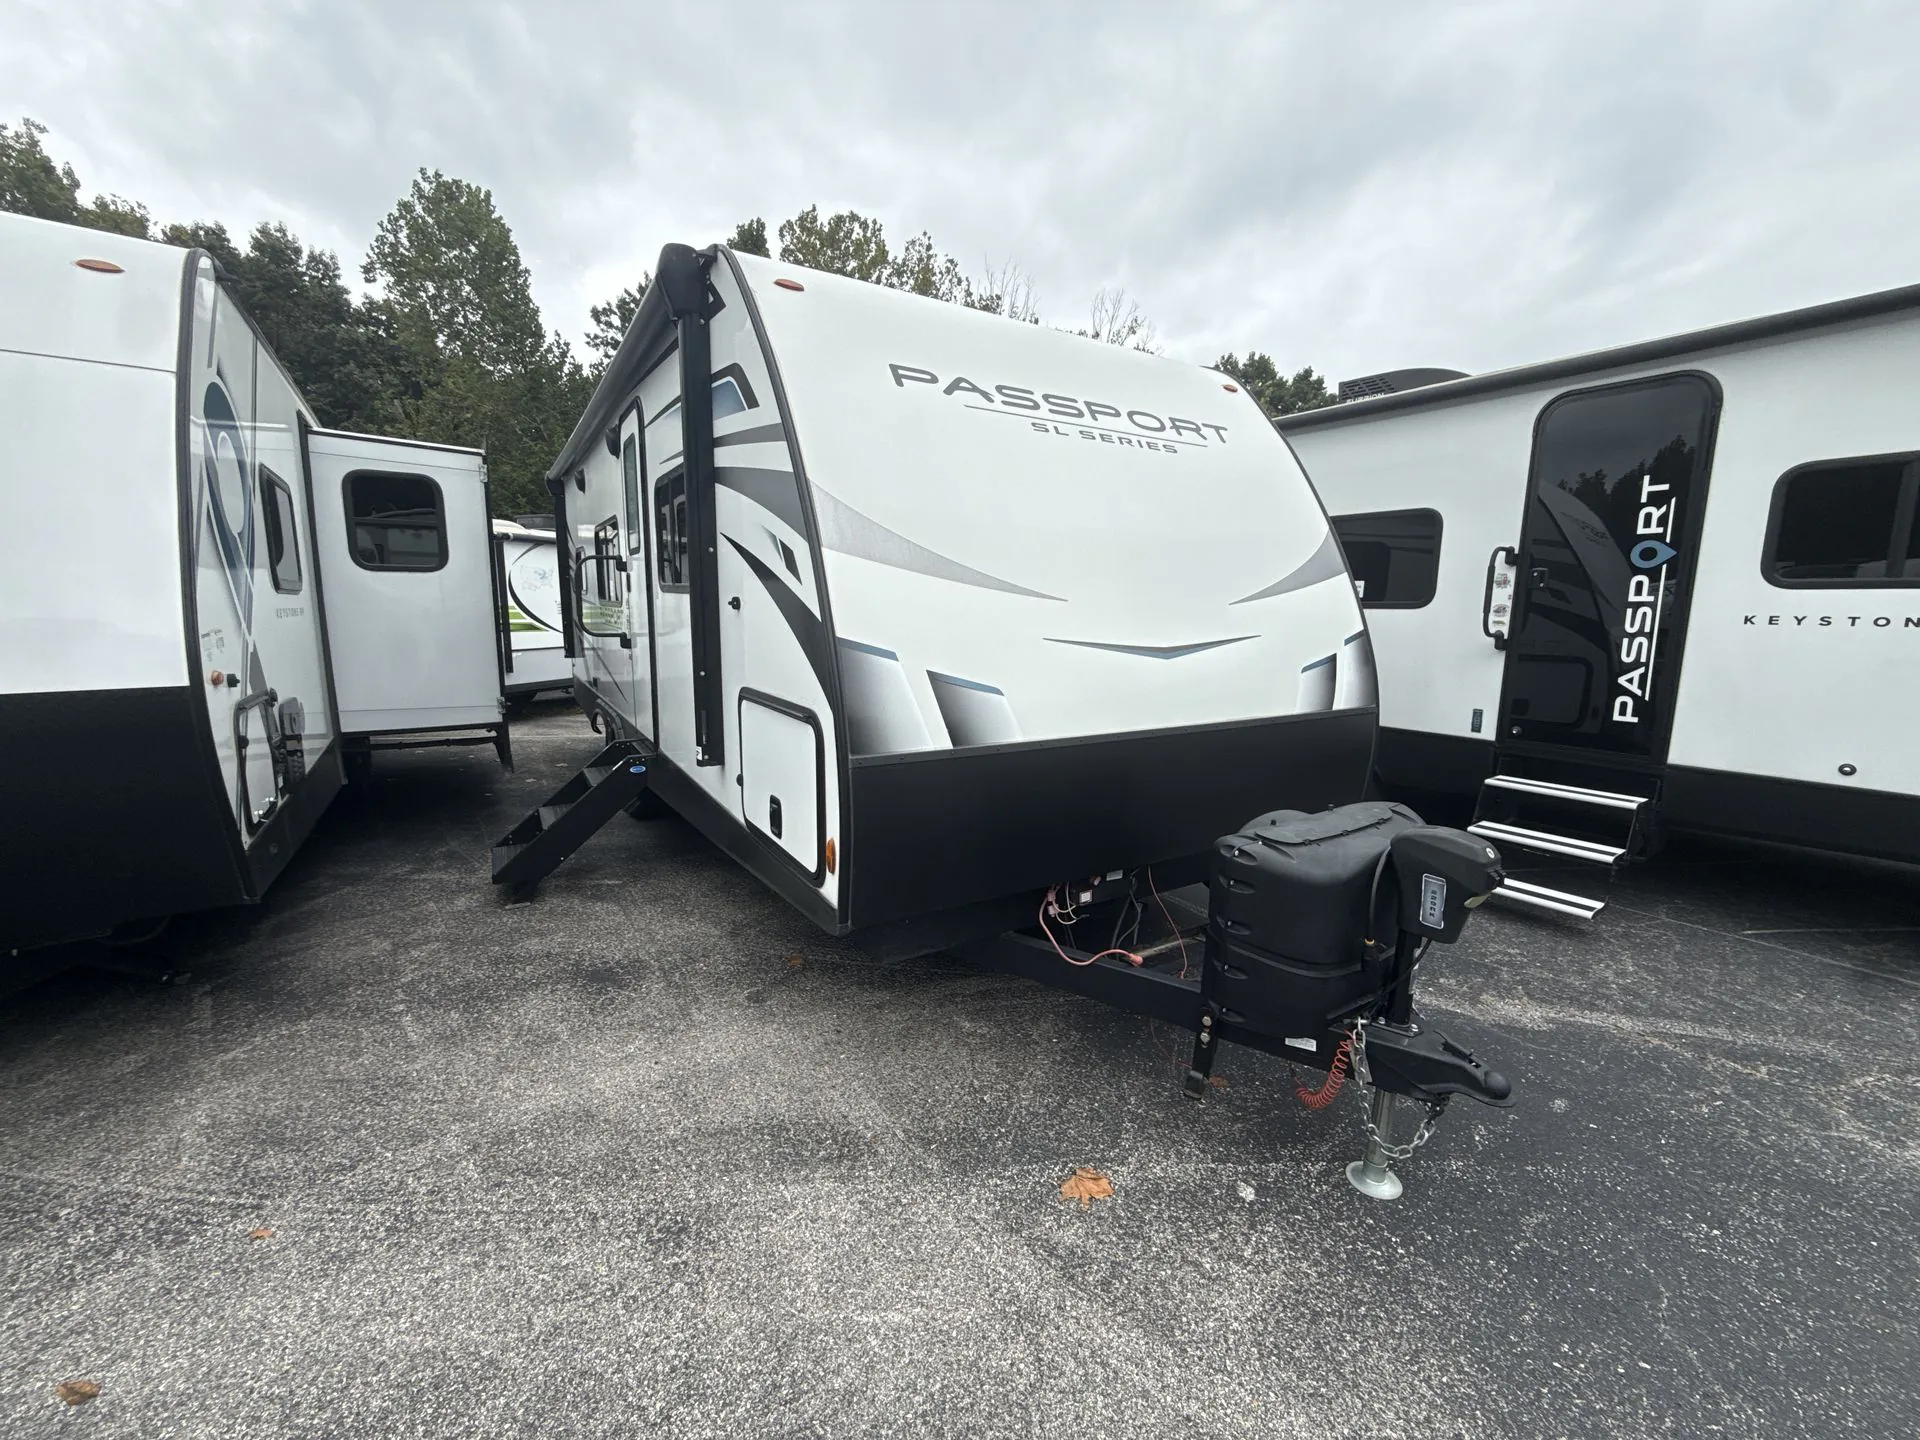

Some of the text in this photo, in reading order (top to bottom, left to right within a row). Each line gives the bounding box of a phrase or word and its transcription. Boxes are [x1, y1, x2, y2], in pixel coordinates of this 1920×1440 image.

[888, 363, 1228, 443] PASSPORT
[1031, 422, 1178, 454] SL SERIES
[1612, 475, 1677, 723] PASSPORT
